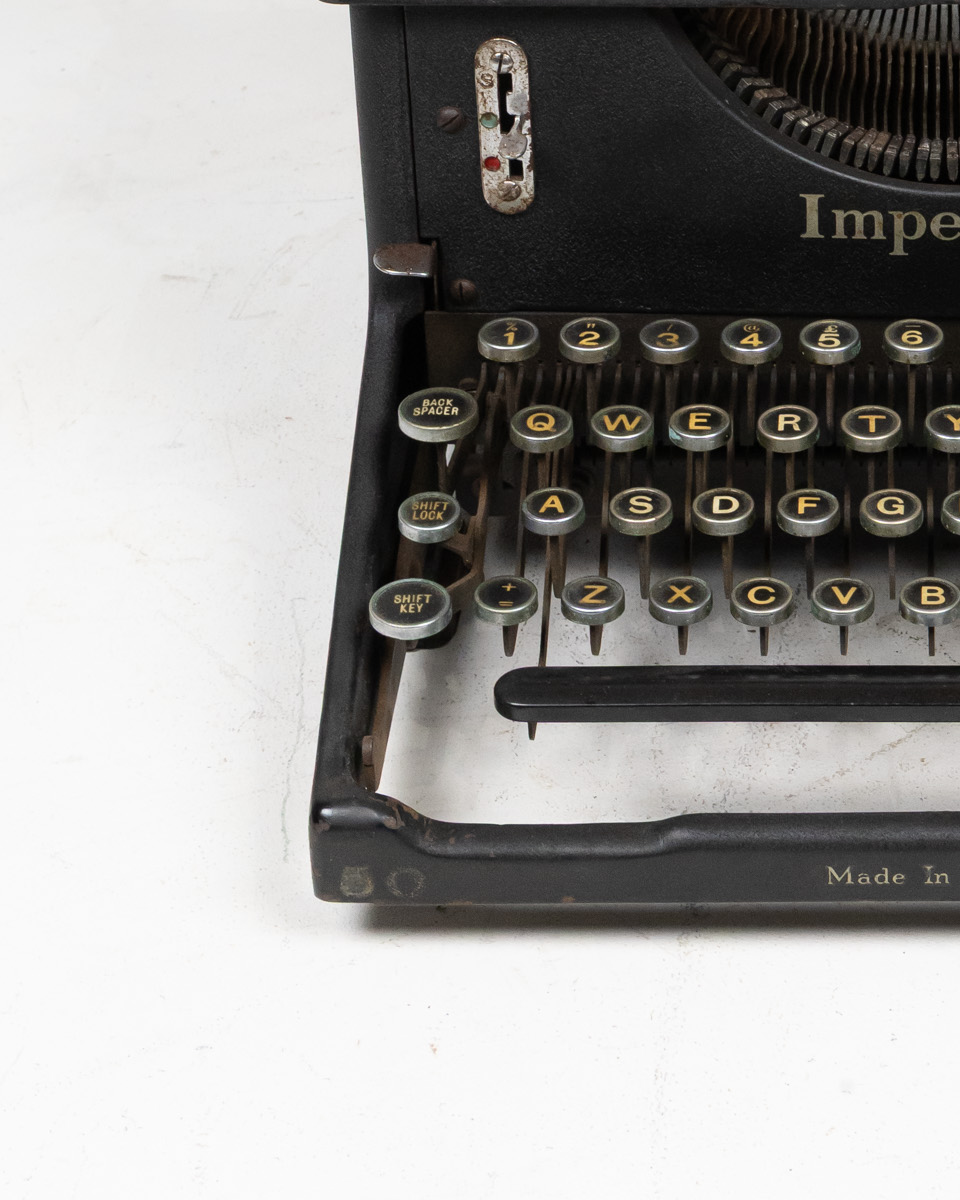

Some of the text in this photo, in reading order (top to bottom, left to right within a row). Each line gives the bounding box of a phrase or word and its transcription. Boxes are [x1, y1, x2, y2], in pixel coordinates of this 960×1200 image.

[503, 331, 515, 346] 1
[578, 331, 601, 346] 2
[656, 332, 680, 347] 3
[739, 332, 764, 347] 4
[817, 333, 841, 348] 5
[901, 330, 924, 345] 6
[413, 406, 458, 416] SPACER
[422, 398, 453, 407] BACK
[526, 412, 556, 432] Q
[603, 413, 642, 431] W
[688, 412, 712, 430] E
[778, 414, 800, 431] R
[858, 415, 886, 432] T
[411, 500, 449, 512] SHIFT
[539, 495, 564, 513] A
[629, 496, 653, 514] S
[713, 496, 739, 514] D
[798, 497, 820, 514] F
[877, 497, 904, 515] G
[412, 511, 444, 521] LOCK
[394, 594, 431, 603] SHIFT
[579, 585, 607, 603] Z
[668, 586, 693, 603] X
[748, 586, 775, 604] C
[832, 586, 856, 604] V
[921, 586, 945, 604] B
[400, 603, 423, 613] KEY
[828, 867, 904, 884] Made
[925, 866, 949, 884] In
